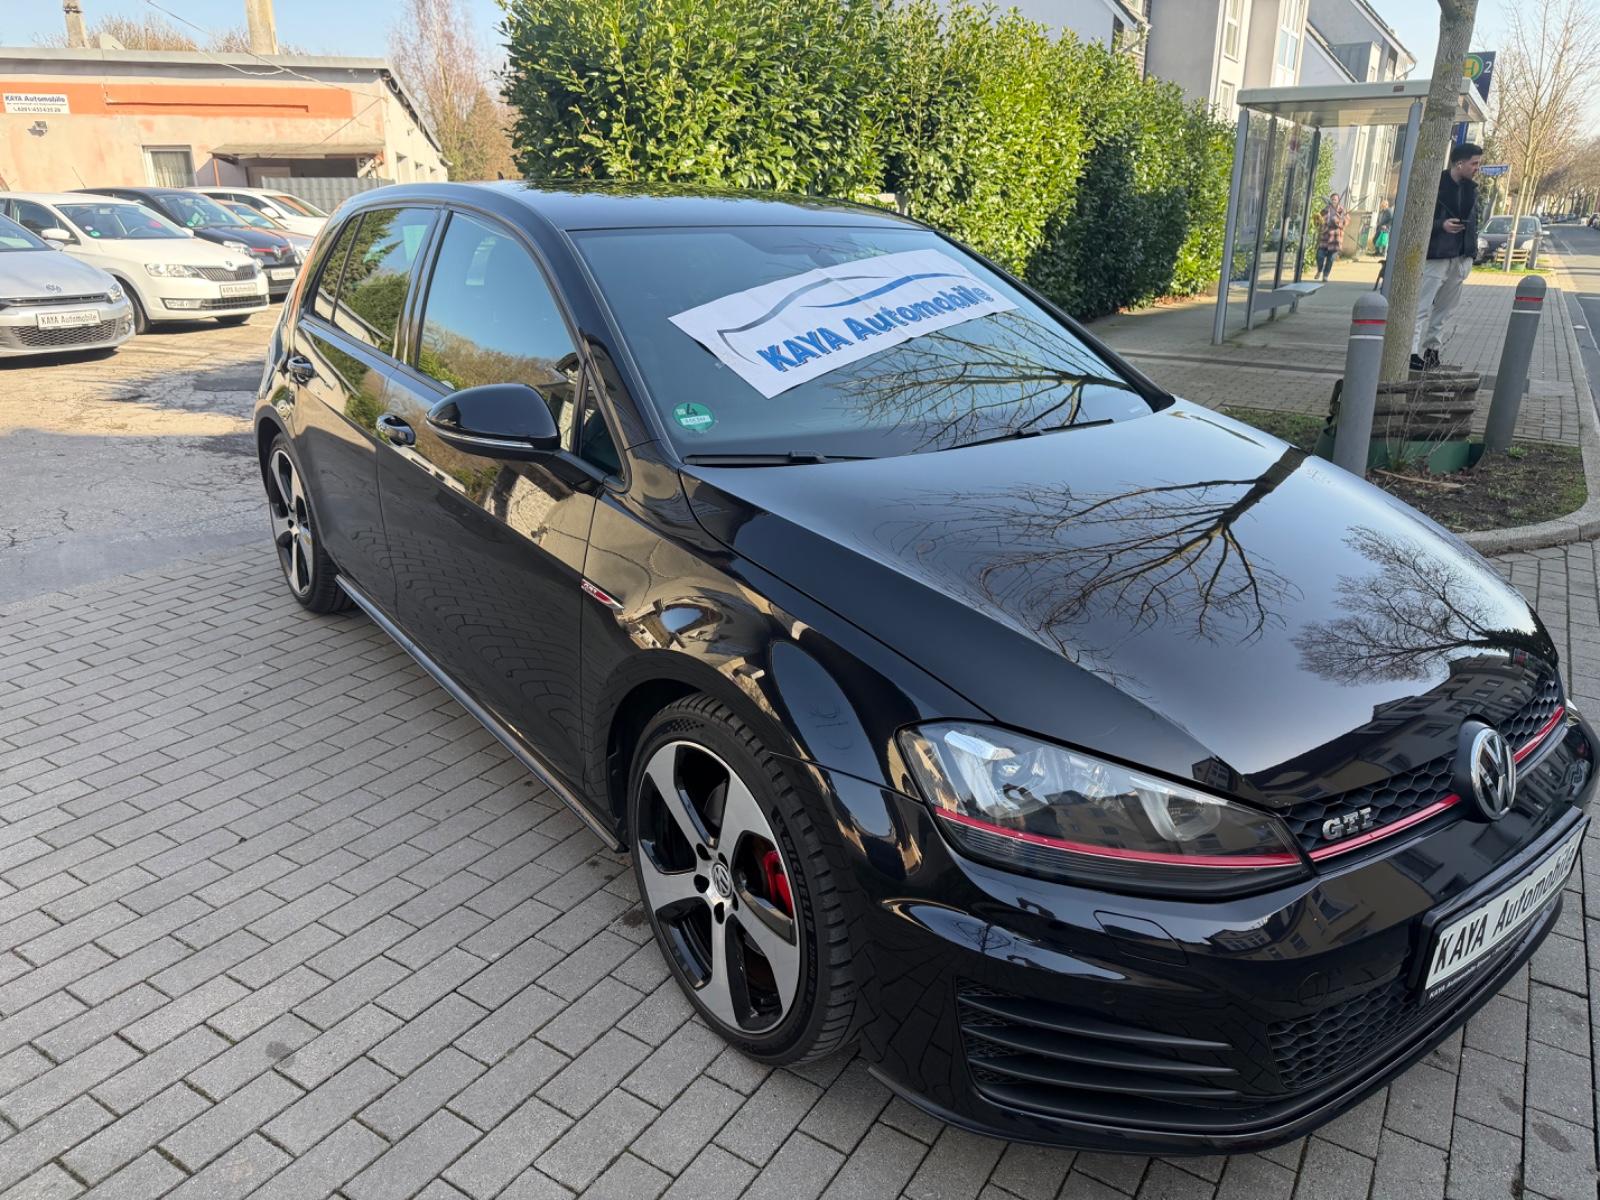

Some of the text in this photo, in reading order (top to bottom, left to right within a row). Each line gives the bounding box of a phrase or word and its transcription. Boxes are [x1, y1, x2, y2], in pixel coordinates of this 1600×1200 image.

[1484, 61, 1493, 74] 2
[41, 313, 97, 325] KAYA Automobile
[756, 284, 995, 373] KAYA Automobile
[1322, 807, 1373, 840] GTI
[781, 832, 816, 934] MICHELIN
[1433, 912, 1489, 975] KAYA
[1492, 846, 1575, 938] Automobile
